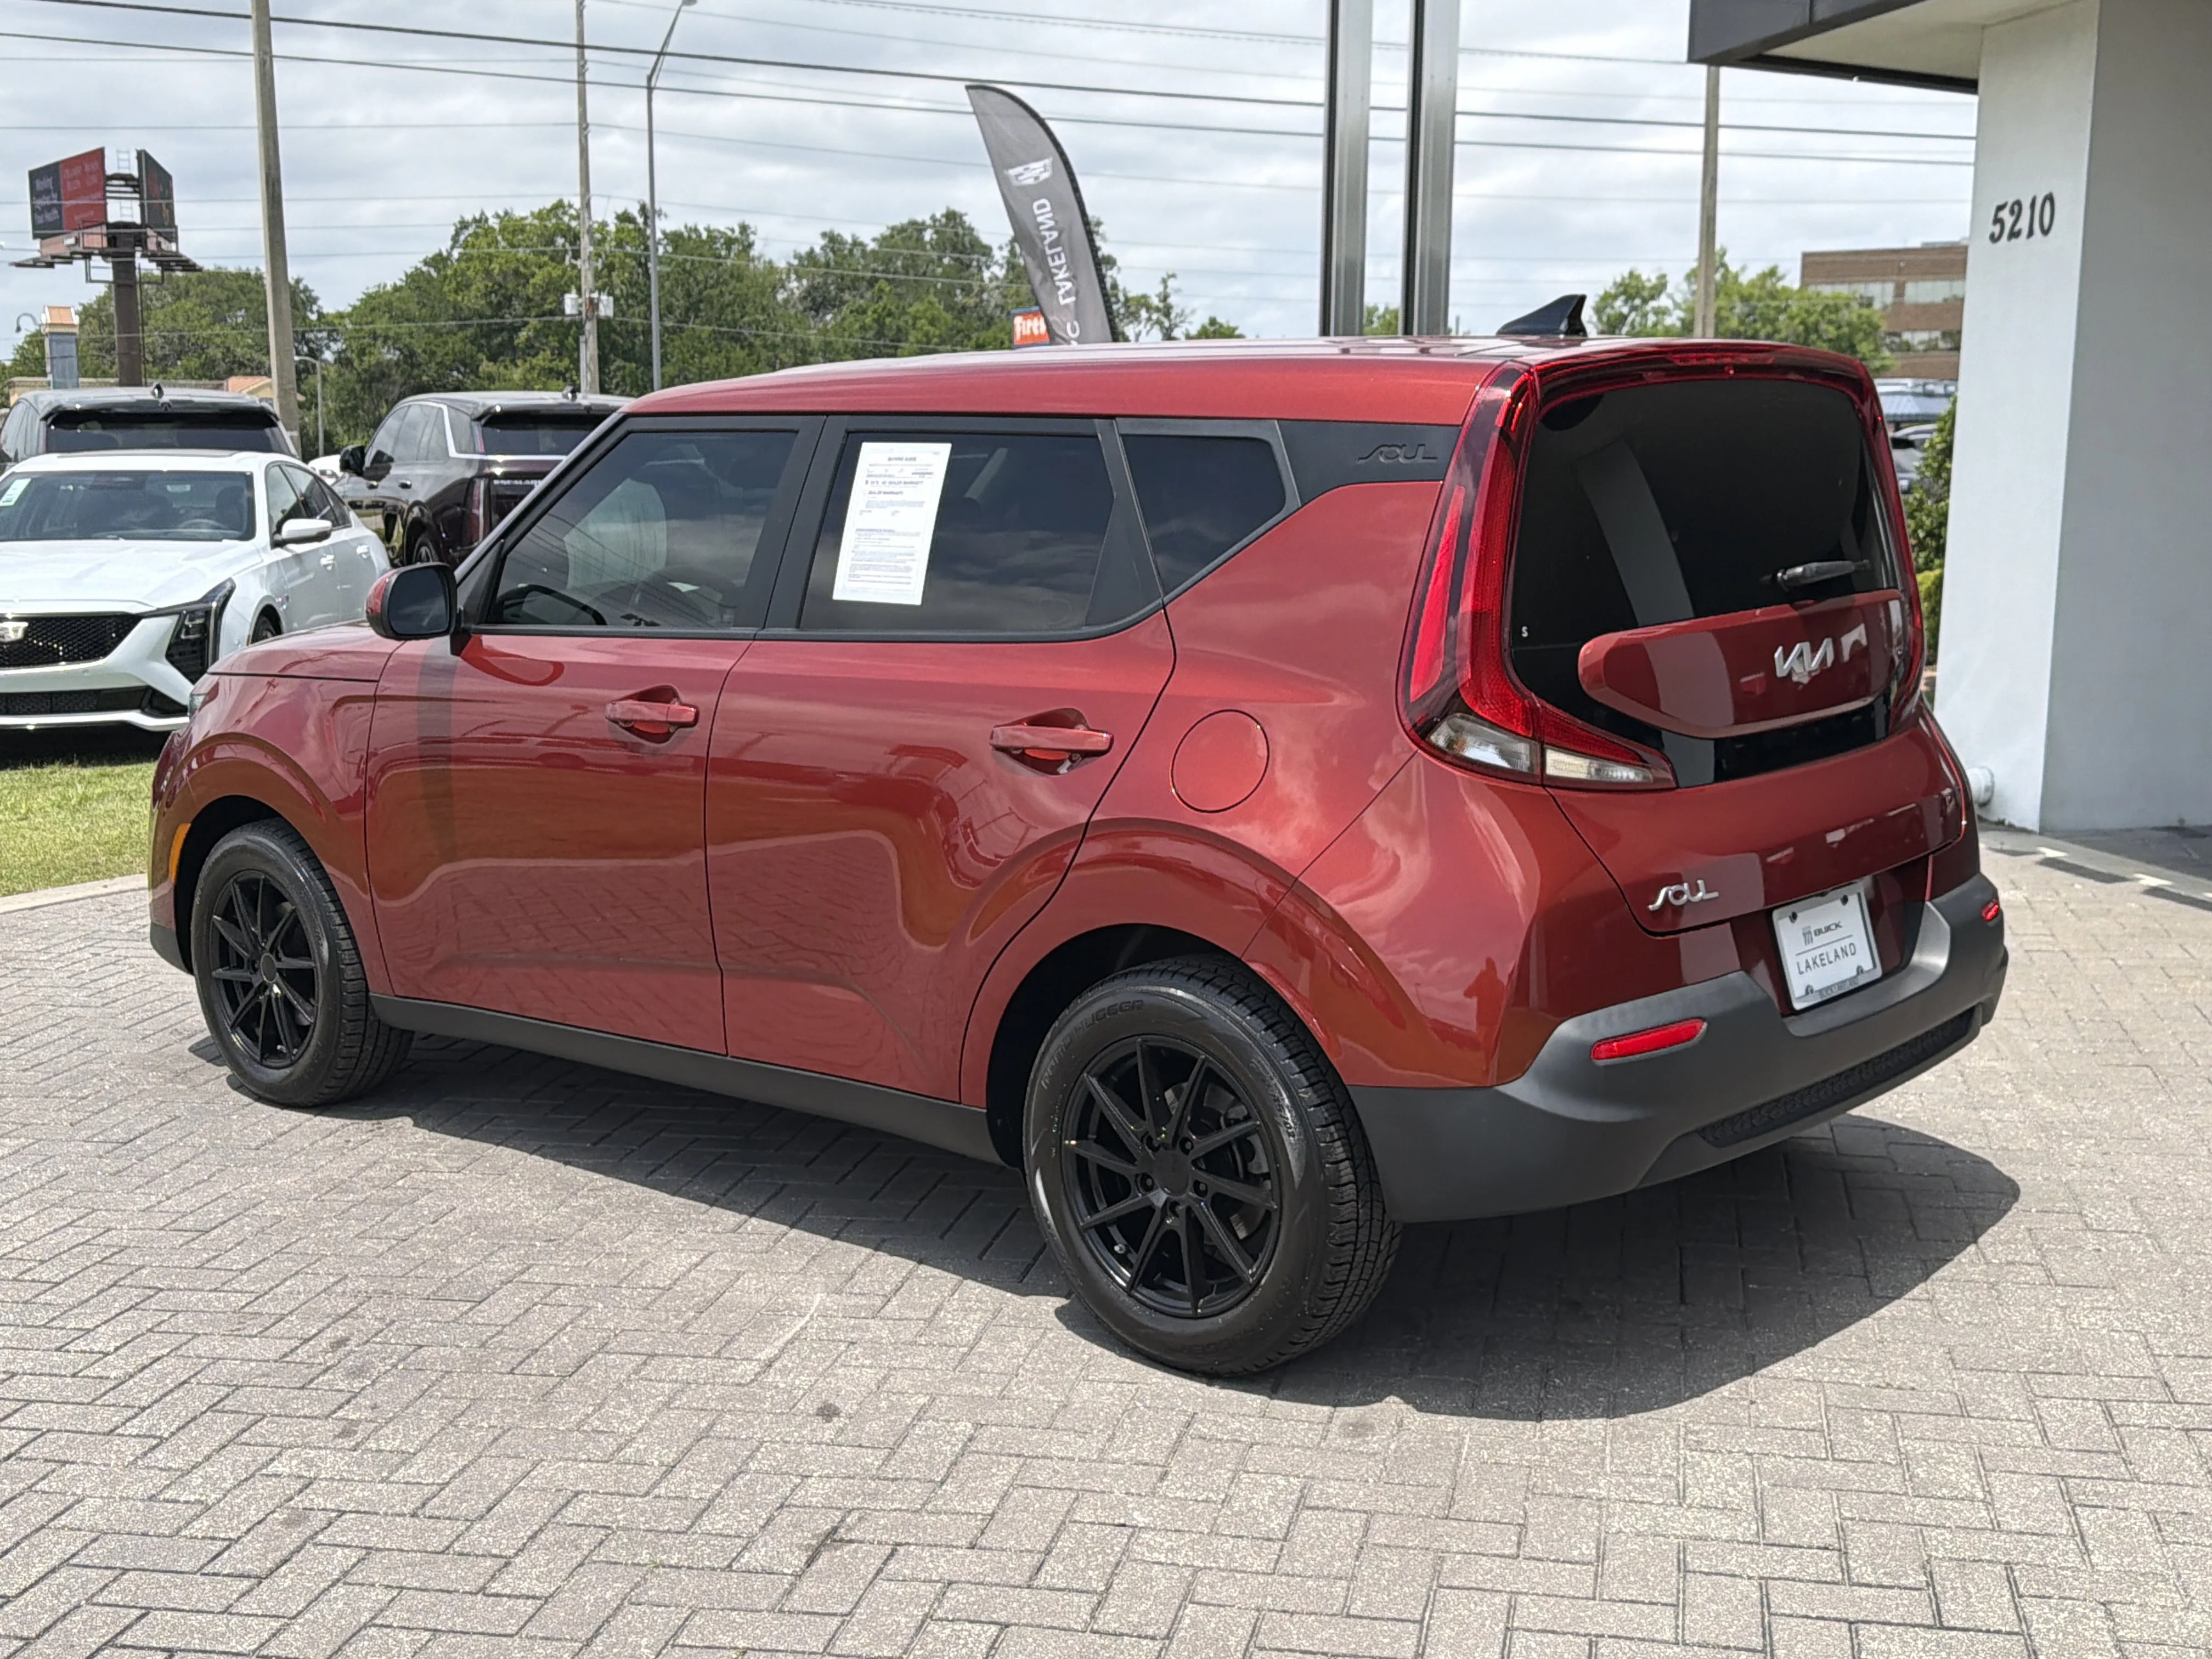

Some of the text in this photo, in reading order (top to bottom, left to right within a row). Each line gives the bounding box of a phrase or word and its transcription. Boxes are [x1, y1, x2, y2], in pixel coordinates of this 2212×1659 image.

[1989, 191, 2055, 244] 5210
[1356, 443, 1438, 463] SOUL
[1774, 637, 1835, 678] KIA
[1647, 879, 1719, 911] SOUL
[1813, 921, 1842, 936] BUICK
[1796, 943, 1857, 975] LAKELAND
